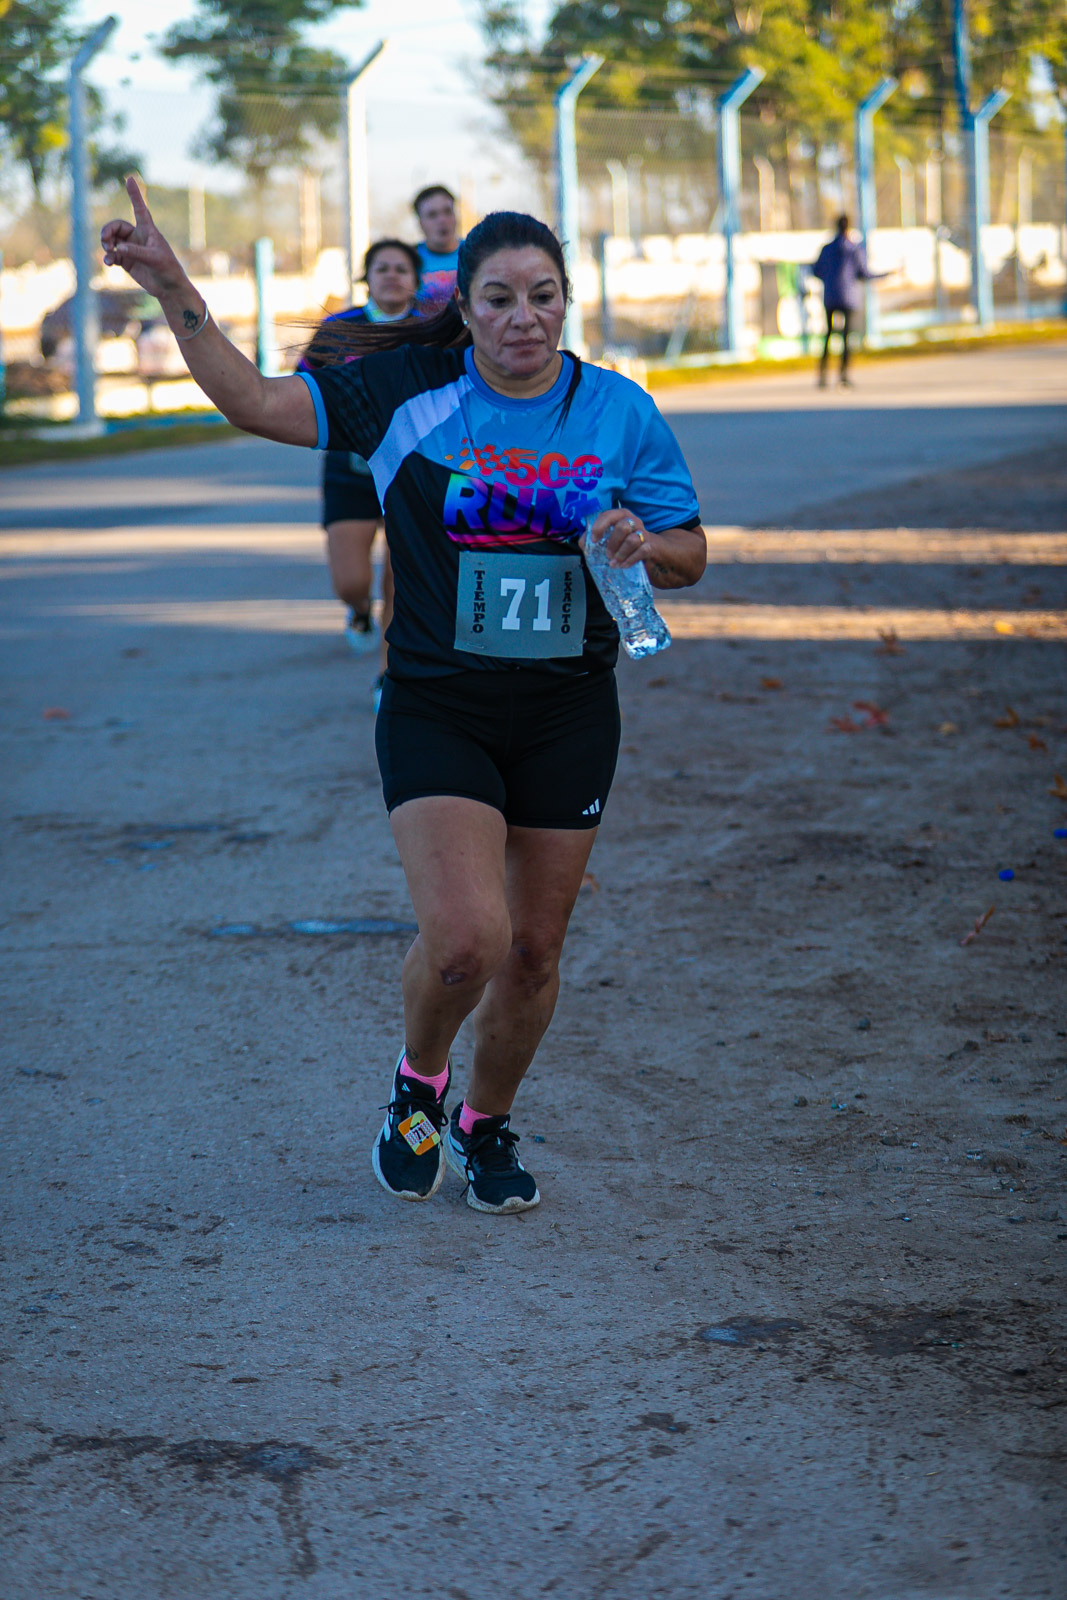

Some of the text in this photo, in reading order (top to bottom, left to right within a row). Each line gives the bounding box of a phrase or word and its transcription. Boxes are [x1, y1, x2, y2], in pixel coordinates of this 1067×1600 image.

[558, 466, 604, 479] MILLAS
[443, 473, 581, 536] RUN
[472, 570, 486, 634] TIEMPO
[500, 578, 551, 631] 71
[561, 571, 573, 634] EXACTO
